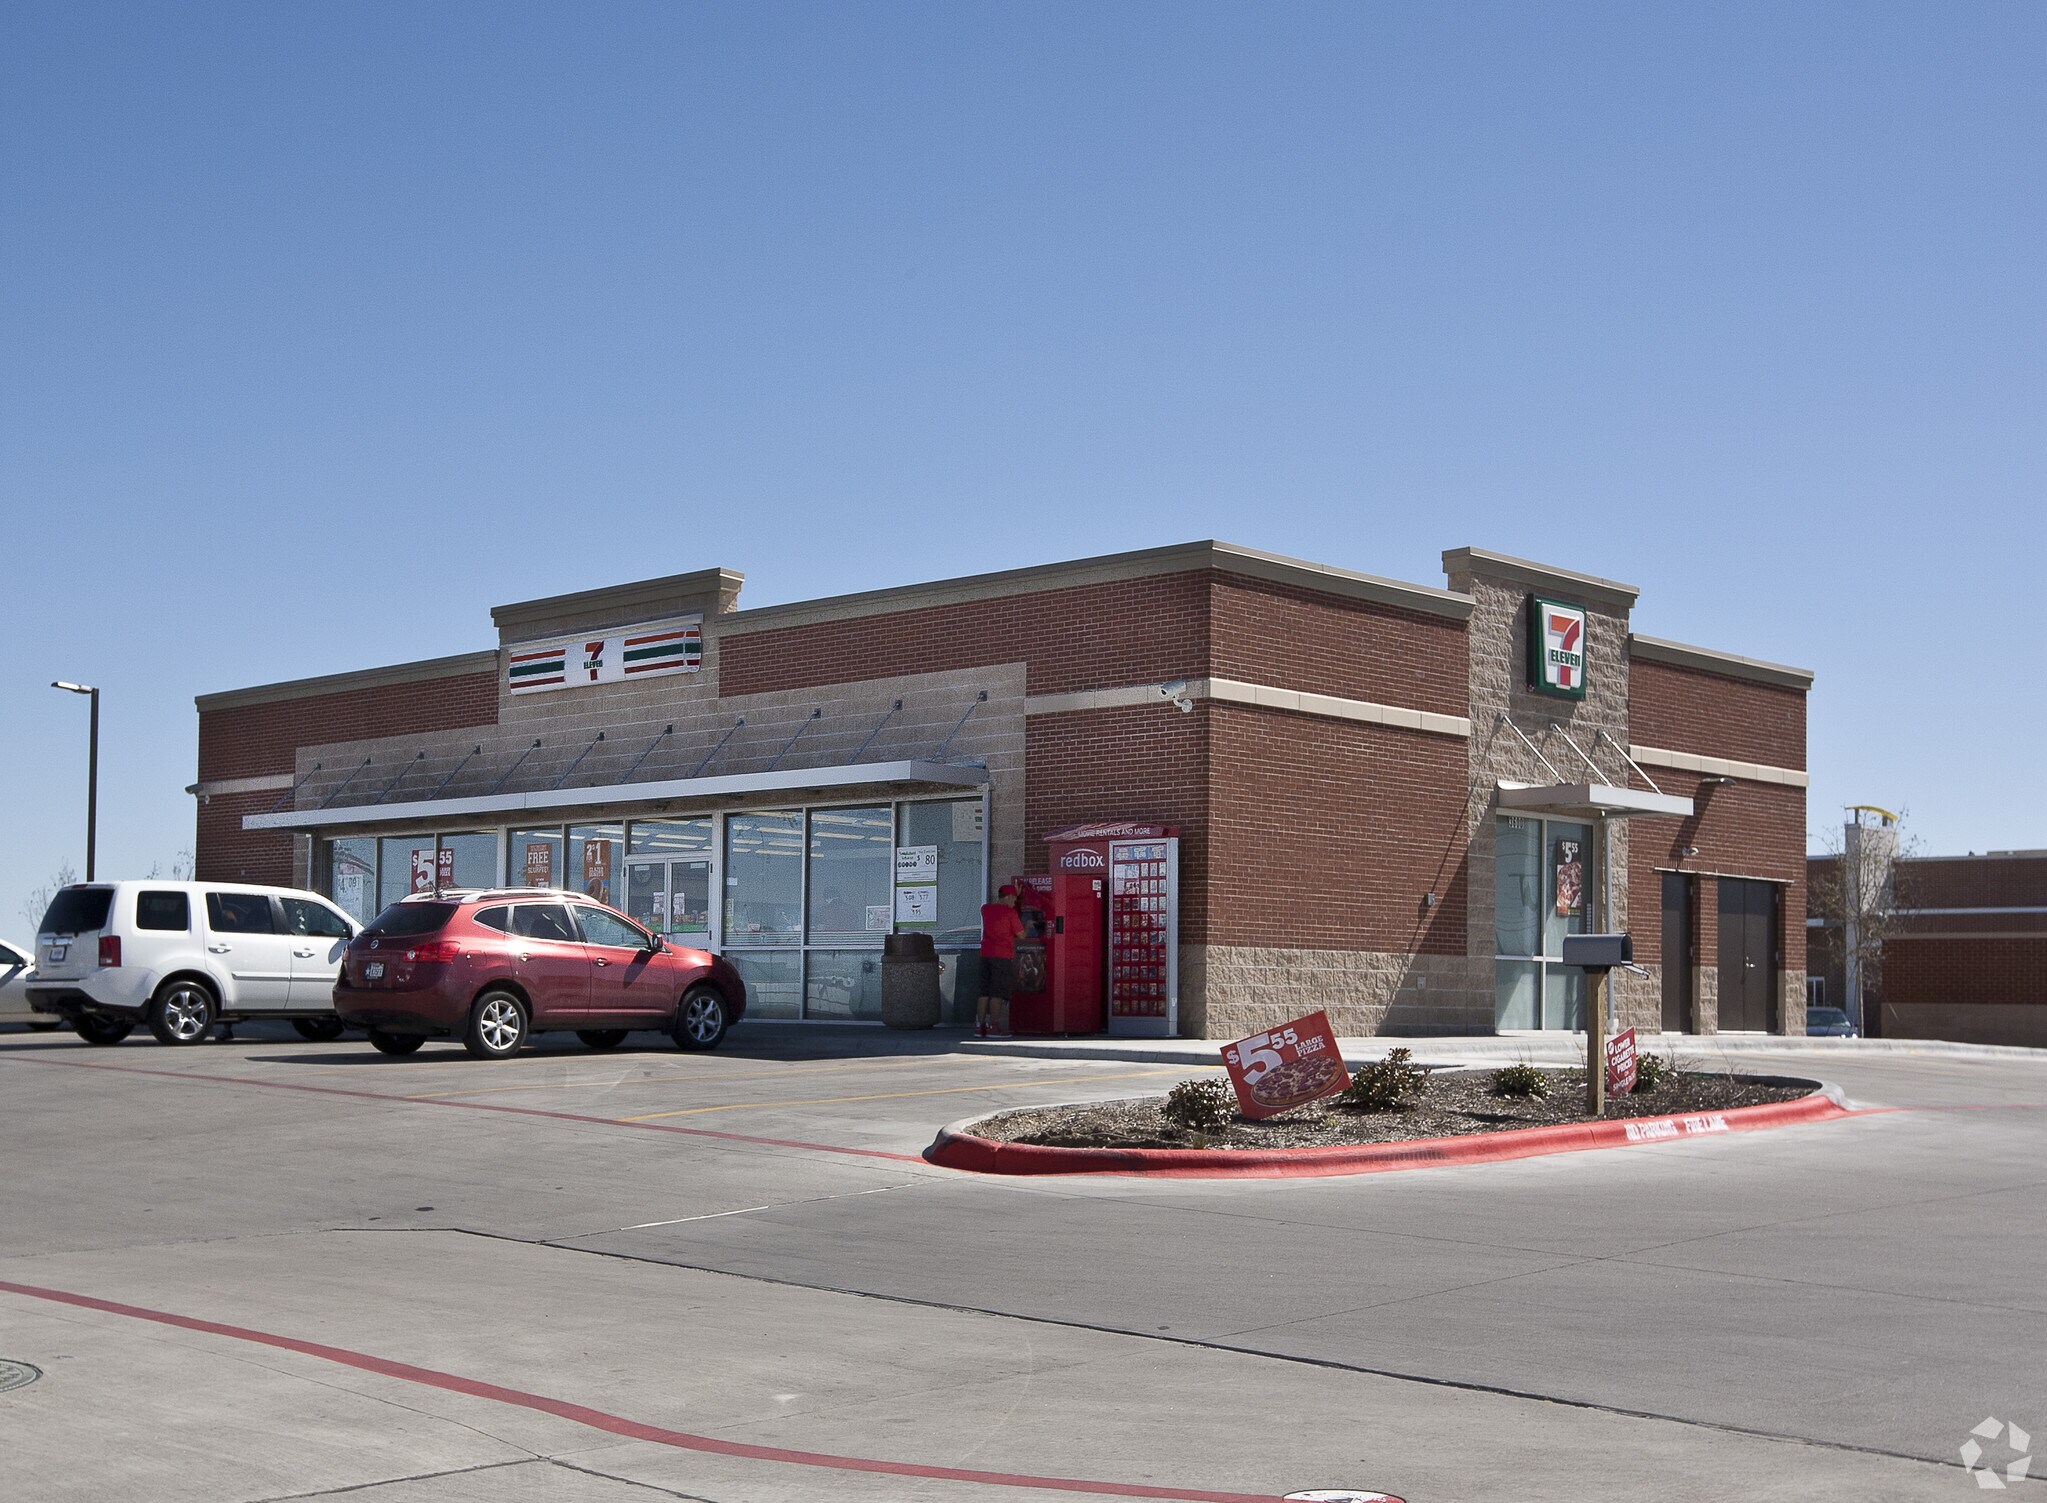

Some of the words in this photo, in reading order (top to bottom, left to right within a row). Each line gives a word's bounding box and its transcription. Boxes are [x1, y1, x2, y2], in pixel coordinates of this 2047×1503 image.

[1120, 828, 1134, 836] AND
[1134, 827, 1151, 835] MORE
[528, 851, 549, 865] FREE
[1060, 853, 1105, 868] redbox
[1294, 1035, 1324, 1051] LARGE
[1297, 1042, 1326, 1057] PIZZA
[1624, 1123, 1641, 1141] NO
[1638, 1120, 1679, 1139] PARKING
